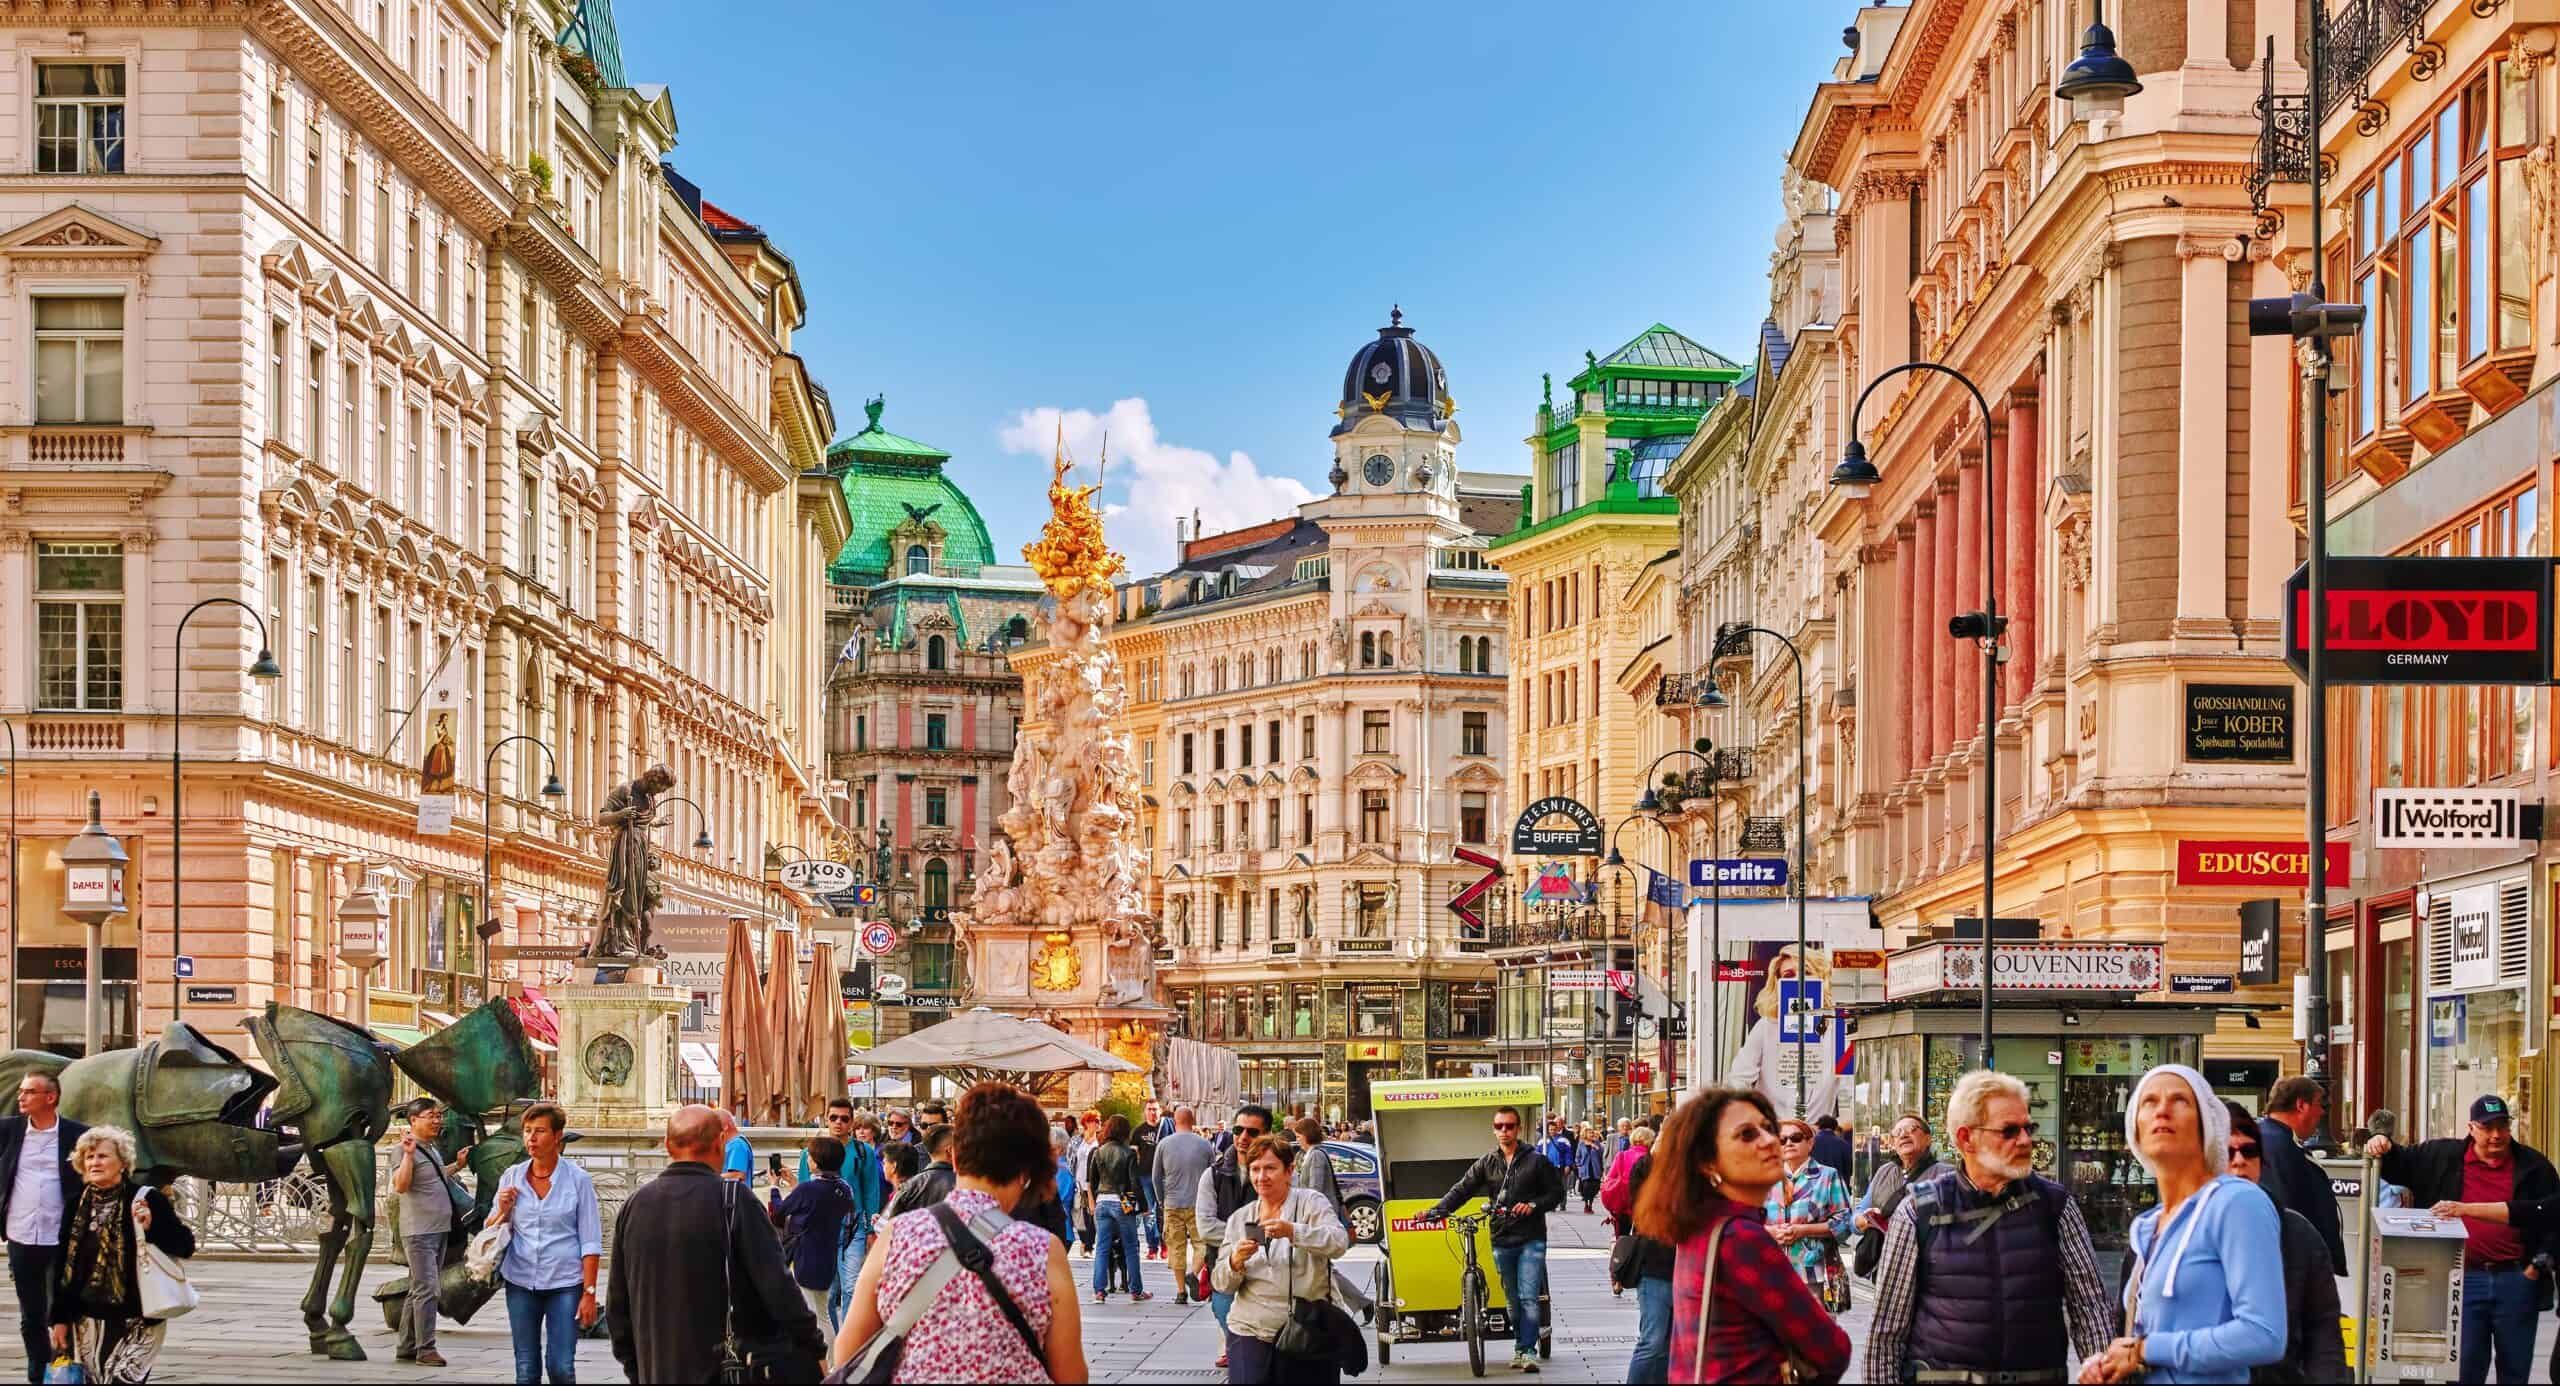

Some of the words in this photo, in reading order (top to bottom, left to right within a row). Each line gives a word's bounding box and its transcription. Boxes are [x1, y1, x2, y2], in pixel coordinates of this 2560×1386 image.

[2326, 600, 2528, 641] LOYD
[2387, 654, 2449, 665] GERMANY
[2193, 696, 2286, 711] GROSSHANDLUNG
[2224, 715, 2285, 733] KOBER
[1518, 800, 1598, 841] TRZESNIEWSKI
[2405, 808, 2492, 829] Wolford
[1533, 832, 1581, 843] BUFFET
[788, 864, 846, 879] ZIKOS
[1701, 863, 1776, 881] Berlitz
[72, 881, 104, 890] DAMEN
[2243, 939, 2264, 956] MONT
[55, 959, 87, 969] ESCA
[2243, 956, 2264, 972] BLANC
[2190, 984, 2214, 992] gasse
[1440, 1089, 1529, 1099] SIGHTSEEING
[2331, 1180, 2360, 1194] ÖVP
[1393, 1219, 1445, 1231] VIENNA
[2380, 1272, 2393, 1361] GRATIS
